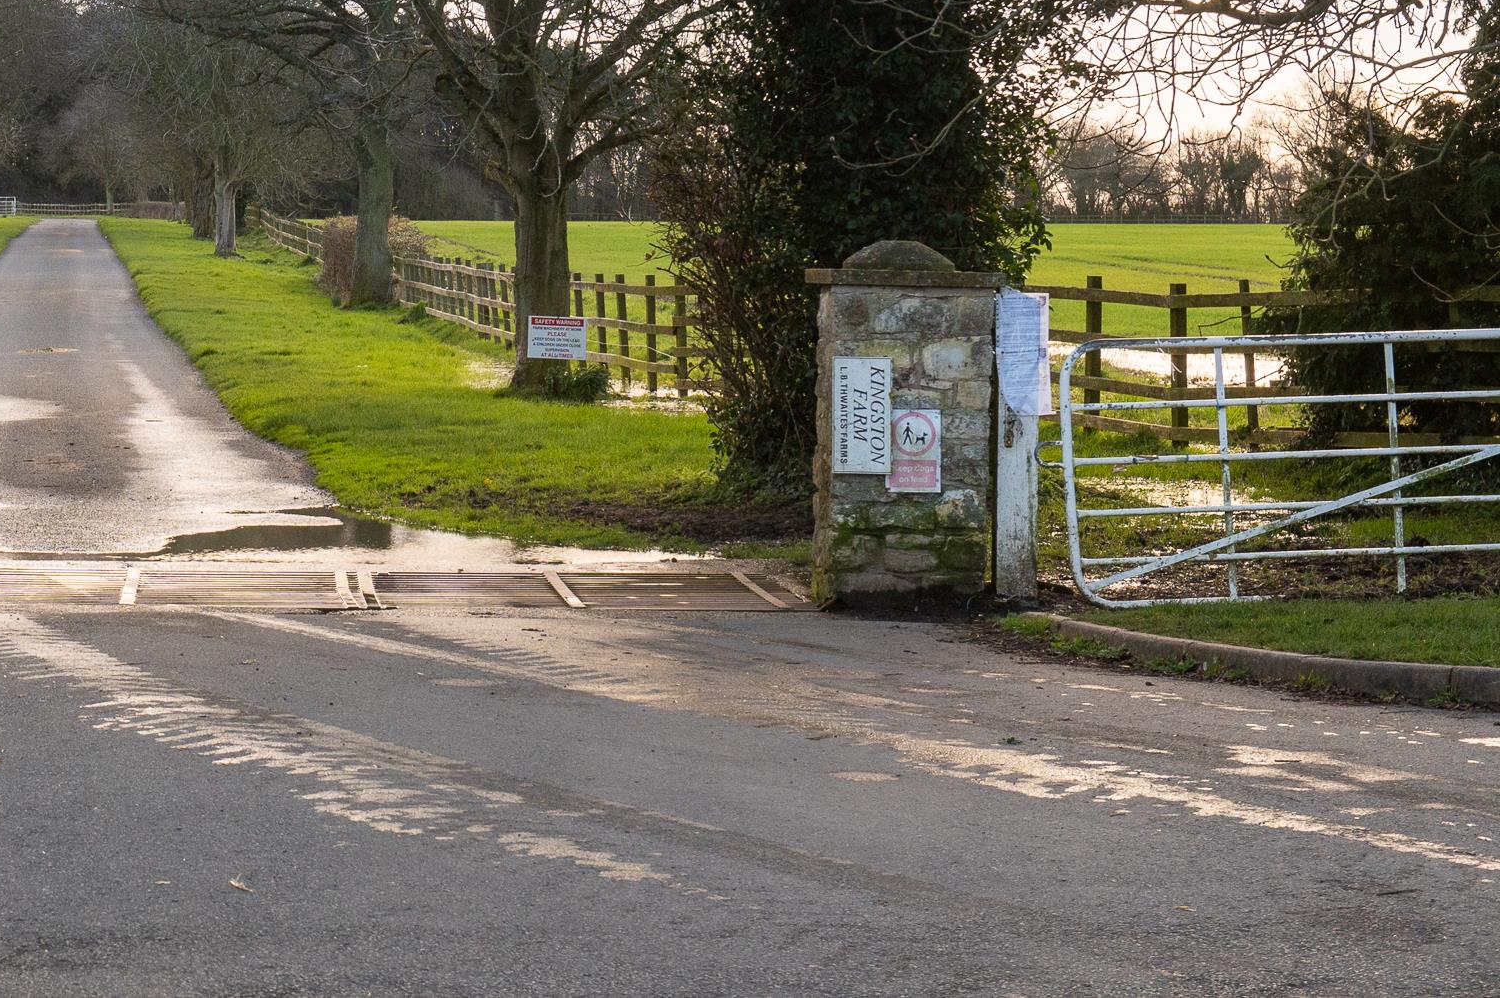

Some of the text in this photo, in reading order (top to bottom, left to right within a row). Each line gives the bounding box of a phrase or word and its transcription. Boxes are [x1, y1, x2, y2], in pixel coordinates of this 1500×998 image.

[853, 388, 868, 442] FARM
[870, 366, 885, 465] KINGSTON
[840, 432, 848, 464] FARMS
[913, 465, 935, 474] dogs
